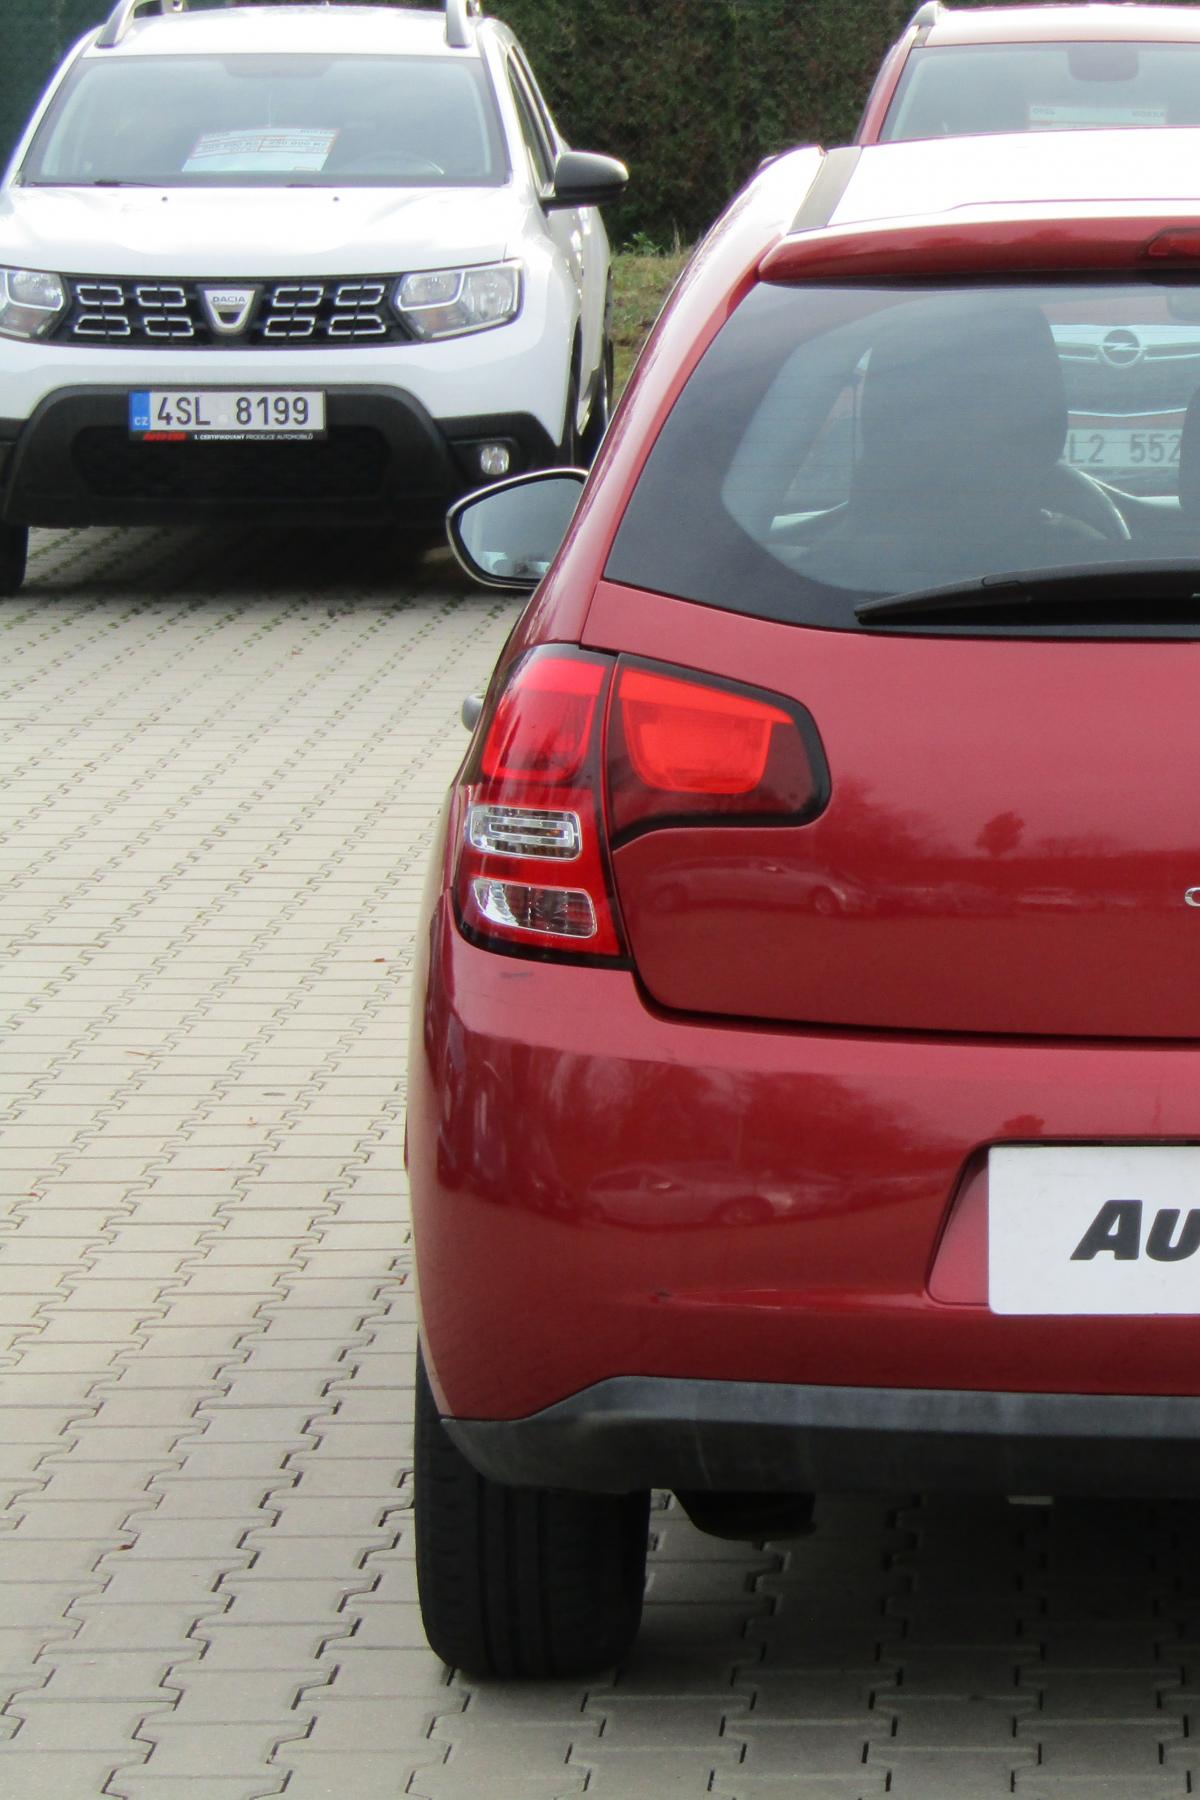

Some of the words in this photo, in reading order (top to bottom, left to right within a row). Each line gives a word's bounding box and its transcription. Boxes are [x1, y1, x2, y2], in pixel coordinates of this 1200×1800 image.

[212, 295, 246, 303] DACIA
[157, 396, 211, 426] 4SL
[235, 396, 309, 426] 8199
[134, 417, 149, 426] CZ
[1062, 432, 1105, 464] L2
